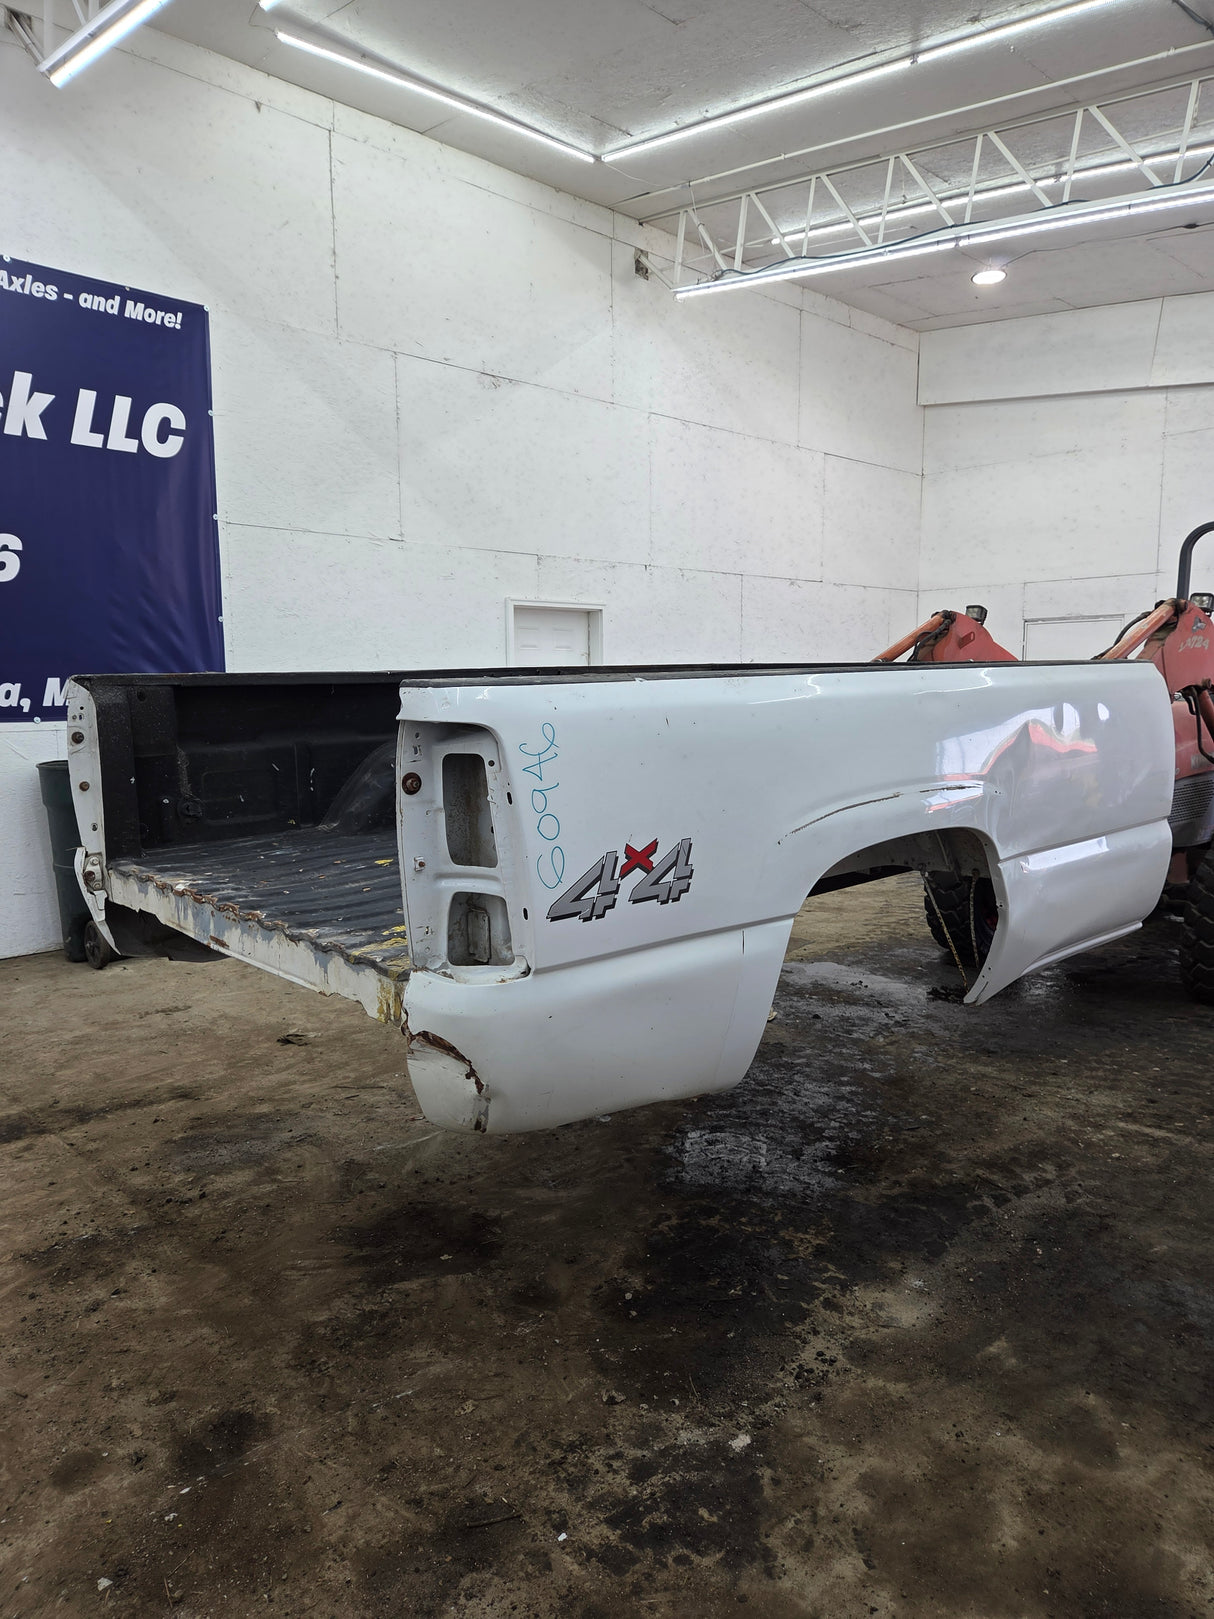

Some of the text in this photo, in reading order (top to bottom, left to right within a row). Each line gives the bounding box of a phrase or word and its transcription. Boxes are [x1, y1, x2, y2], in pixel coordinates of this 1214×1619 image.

[0, 269, 59, 301] Axles
[78, 292, 121, 316] and
[124, 300, 183, 330] More!
[70, 388, 187, 459] LLC
[518, 722, 565, 890] 60946
